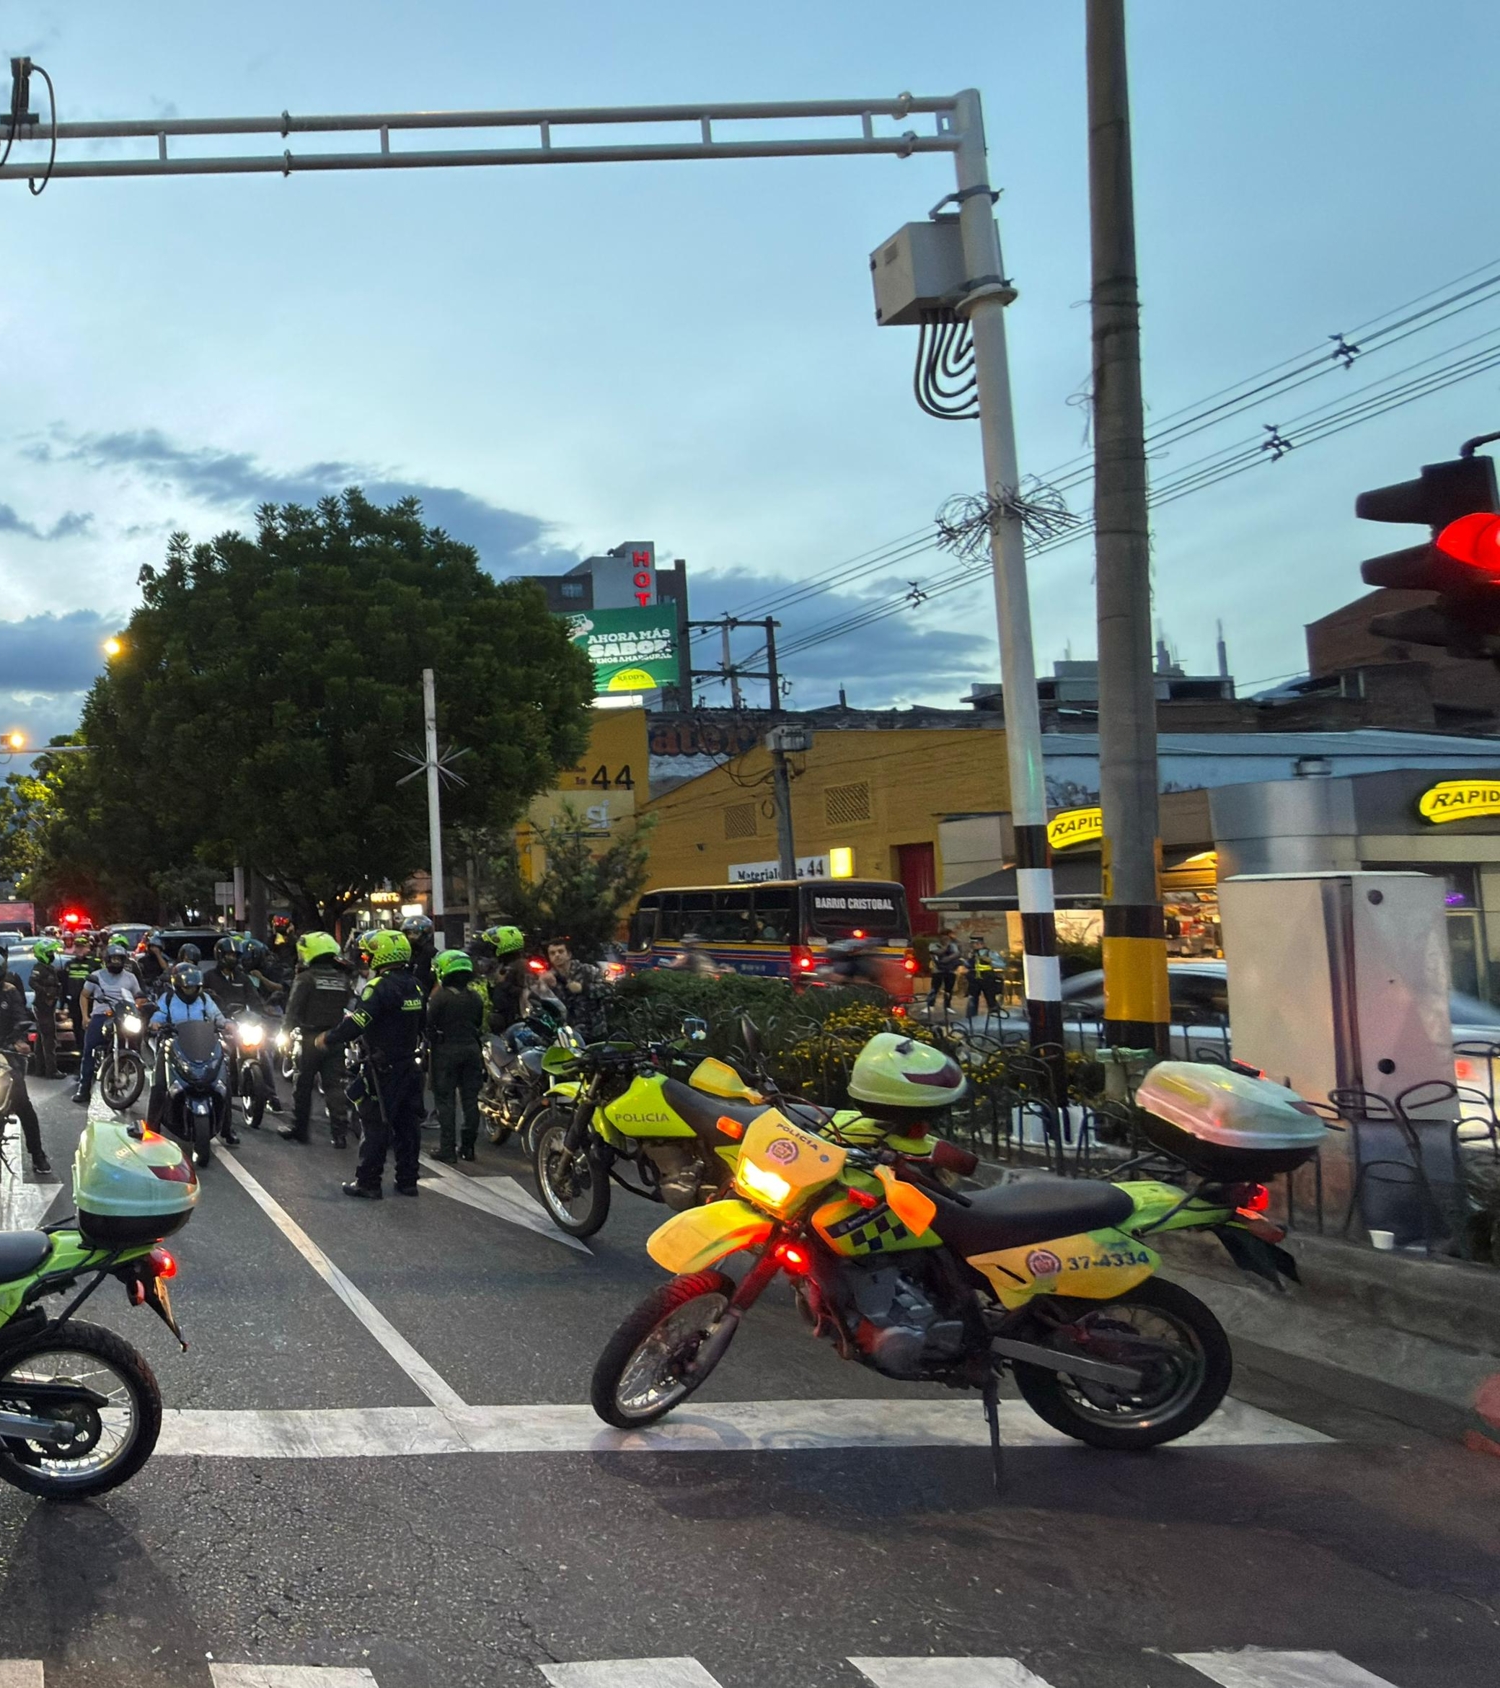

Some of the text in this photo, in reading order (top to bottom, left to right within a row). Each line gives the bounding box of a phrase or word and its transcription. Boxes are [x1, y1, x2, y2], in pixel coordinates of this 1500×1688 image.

[632, 550, 651, 608] HOT
[587, 628, 671, 645] AHORA MÁS
[591, 765, 635, 790] 44
[807, 859, 824, 876] 44
[815, 897, 894, 911] BARRIO CRISTOBAL
